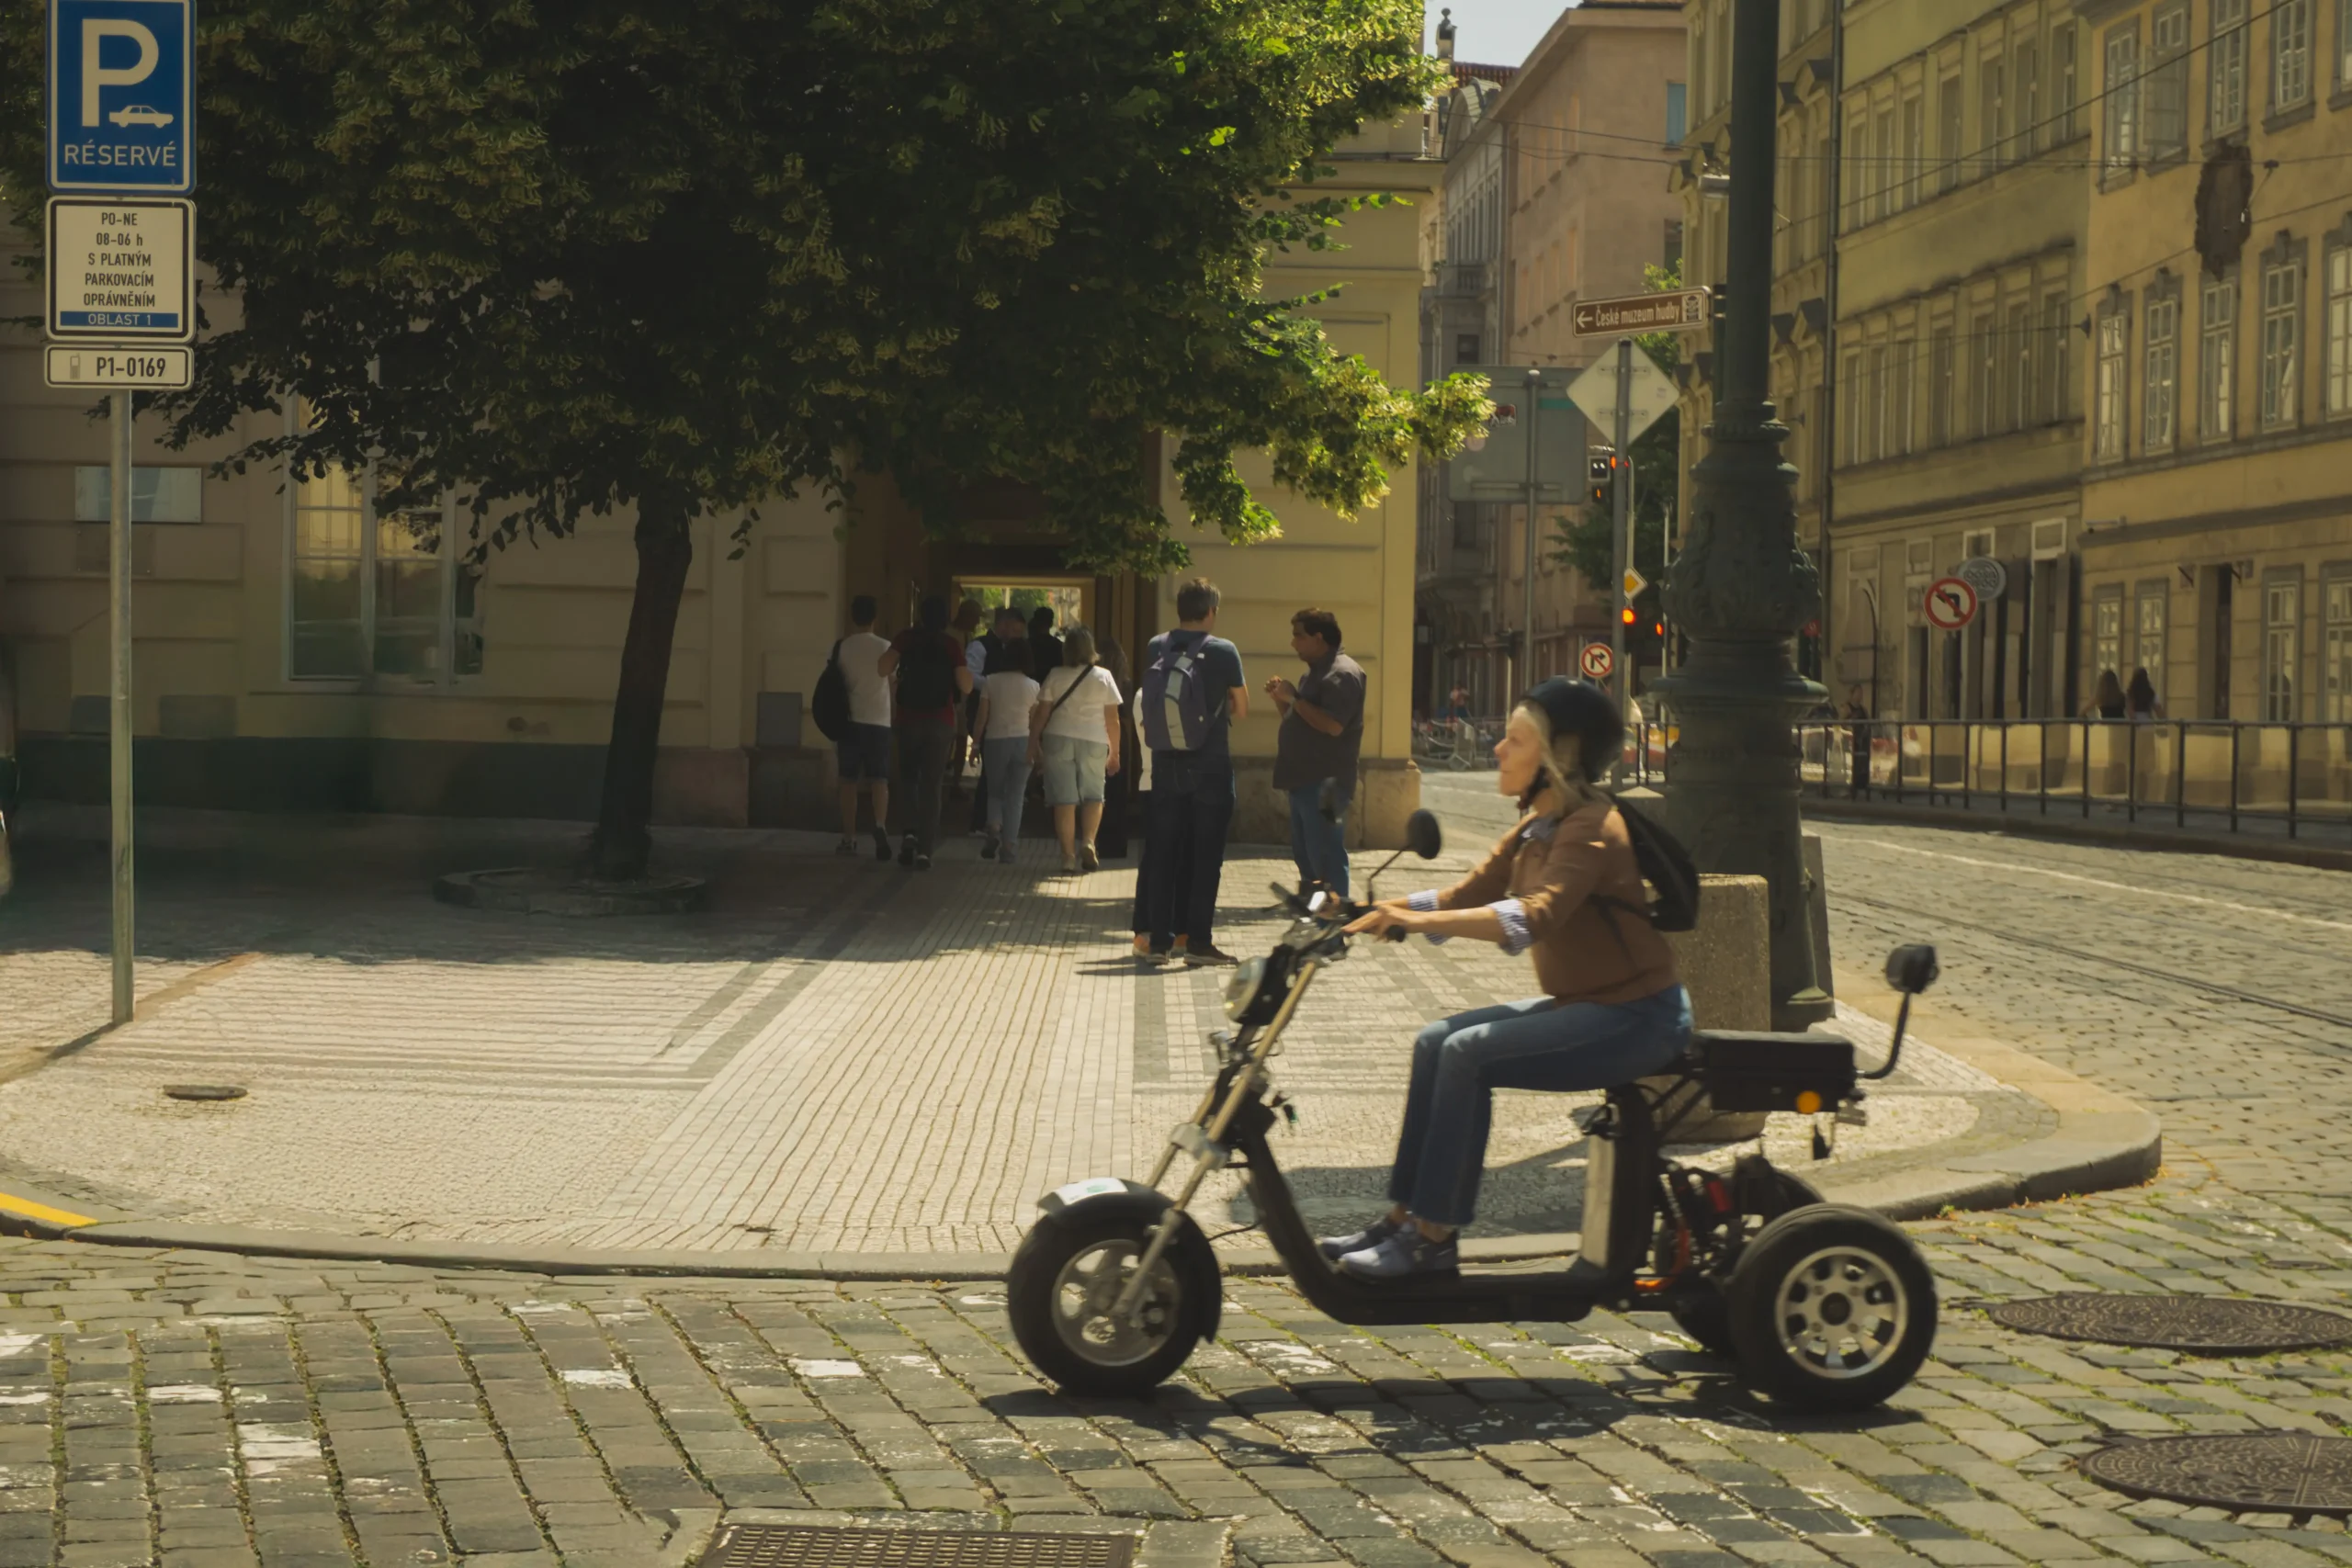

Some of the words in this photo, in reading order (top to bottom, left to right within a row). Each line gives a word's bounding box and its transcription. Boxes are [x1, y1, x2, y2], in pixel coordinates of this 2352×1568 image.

[82, 18, 160, 127] P
[64, 139, 176, 166] RÉSERVÉ
[101, 212, 138, 226] PO-NE
[96, 232, 130, 246] 08-06
[136, 233, 143, 246] h
[88, 253, 96, 265] S
[101, 251, 152, 266] PLATNÝM
[85, 270, 154, 287] PARKOVACÍM
[83, 290, 155, 308] OPRÁVNĚNÍM
[87, 313, 140, 326] OBLAST
[146, 314, 152, 326] 1
[1596, 305, 1620, 327] České
[1621, 307, 1654, 324] muzeum
[1656, 301, 1680, 323] hudby
[96, 356, 166, 378] P1-0169
